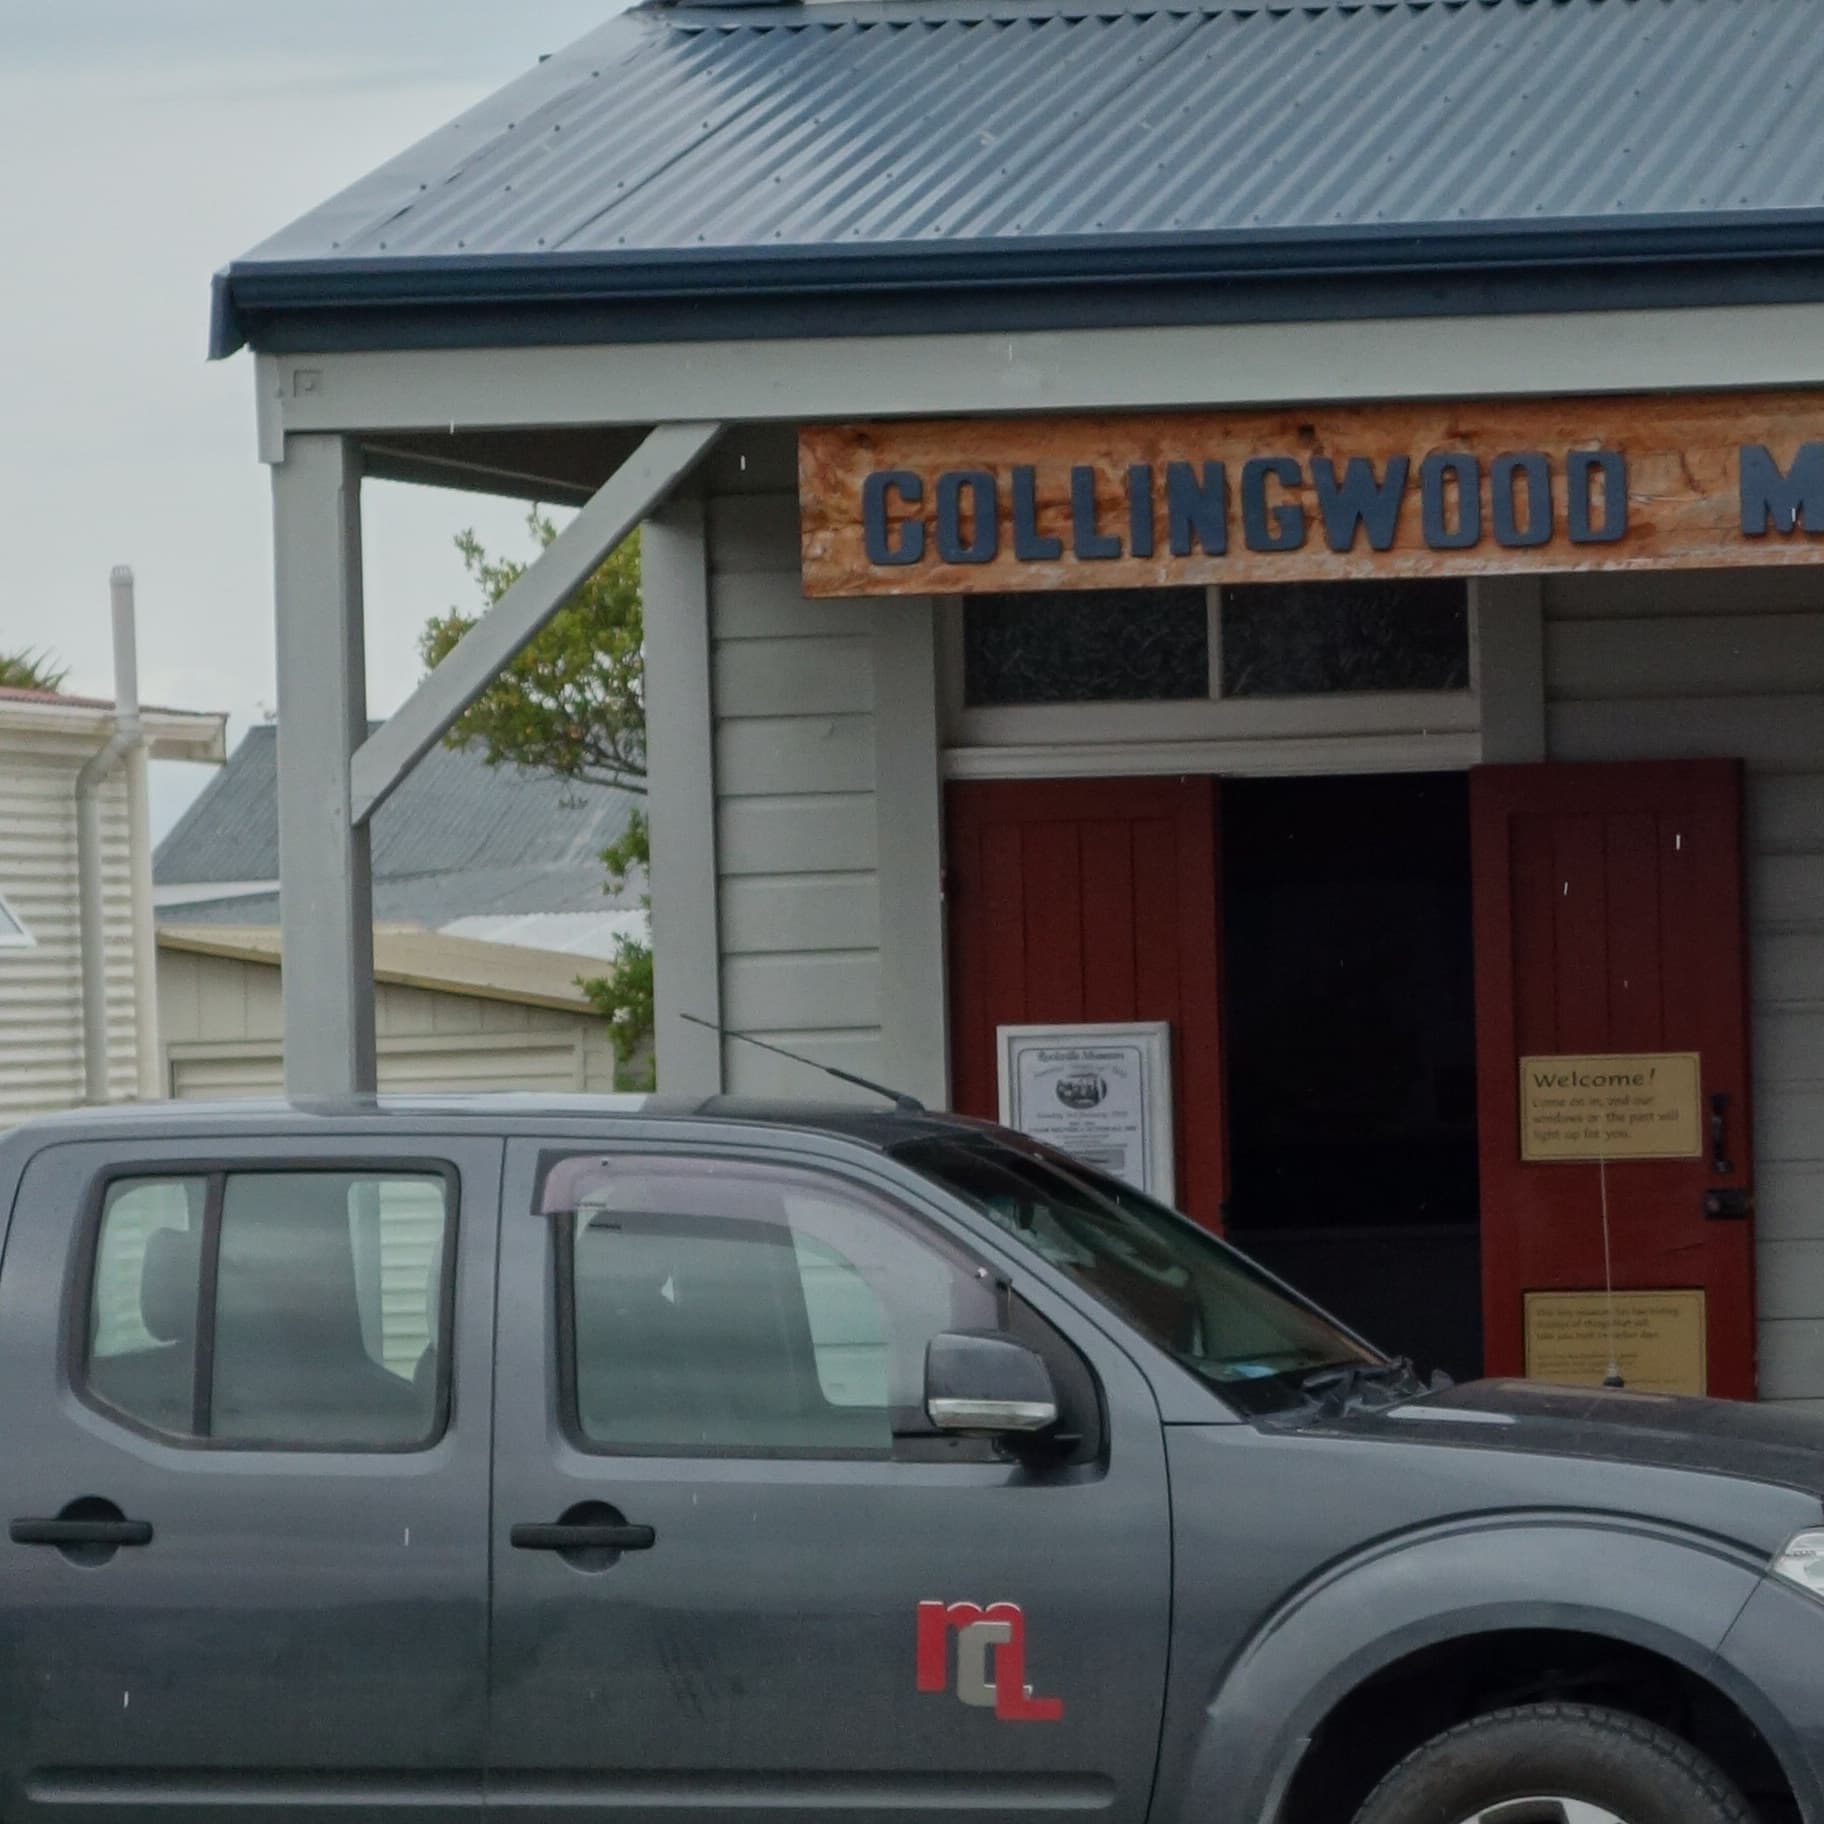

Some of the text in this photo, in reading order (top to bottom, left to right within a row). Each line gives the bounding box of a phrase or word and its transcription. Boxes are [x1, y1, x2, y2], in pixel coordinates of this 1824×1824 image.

[863, 449, 1628, 565] COLLINGWOOD
[1533, 1067, 1656, 1088] Welcome!
[1606, 1112, 1625, 1121] the
